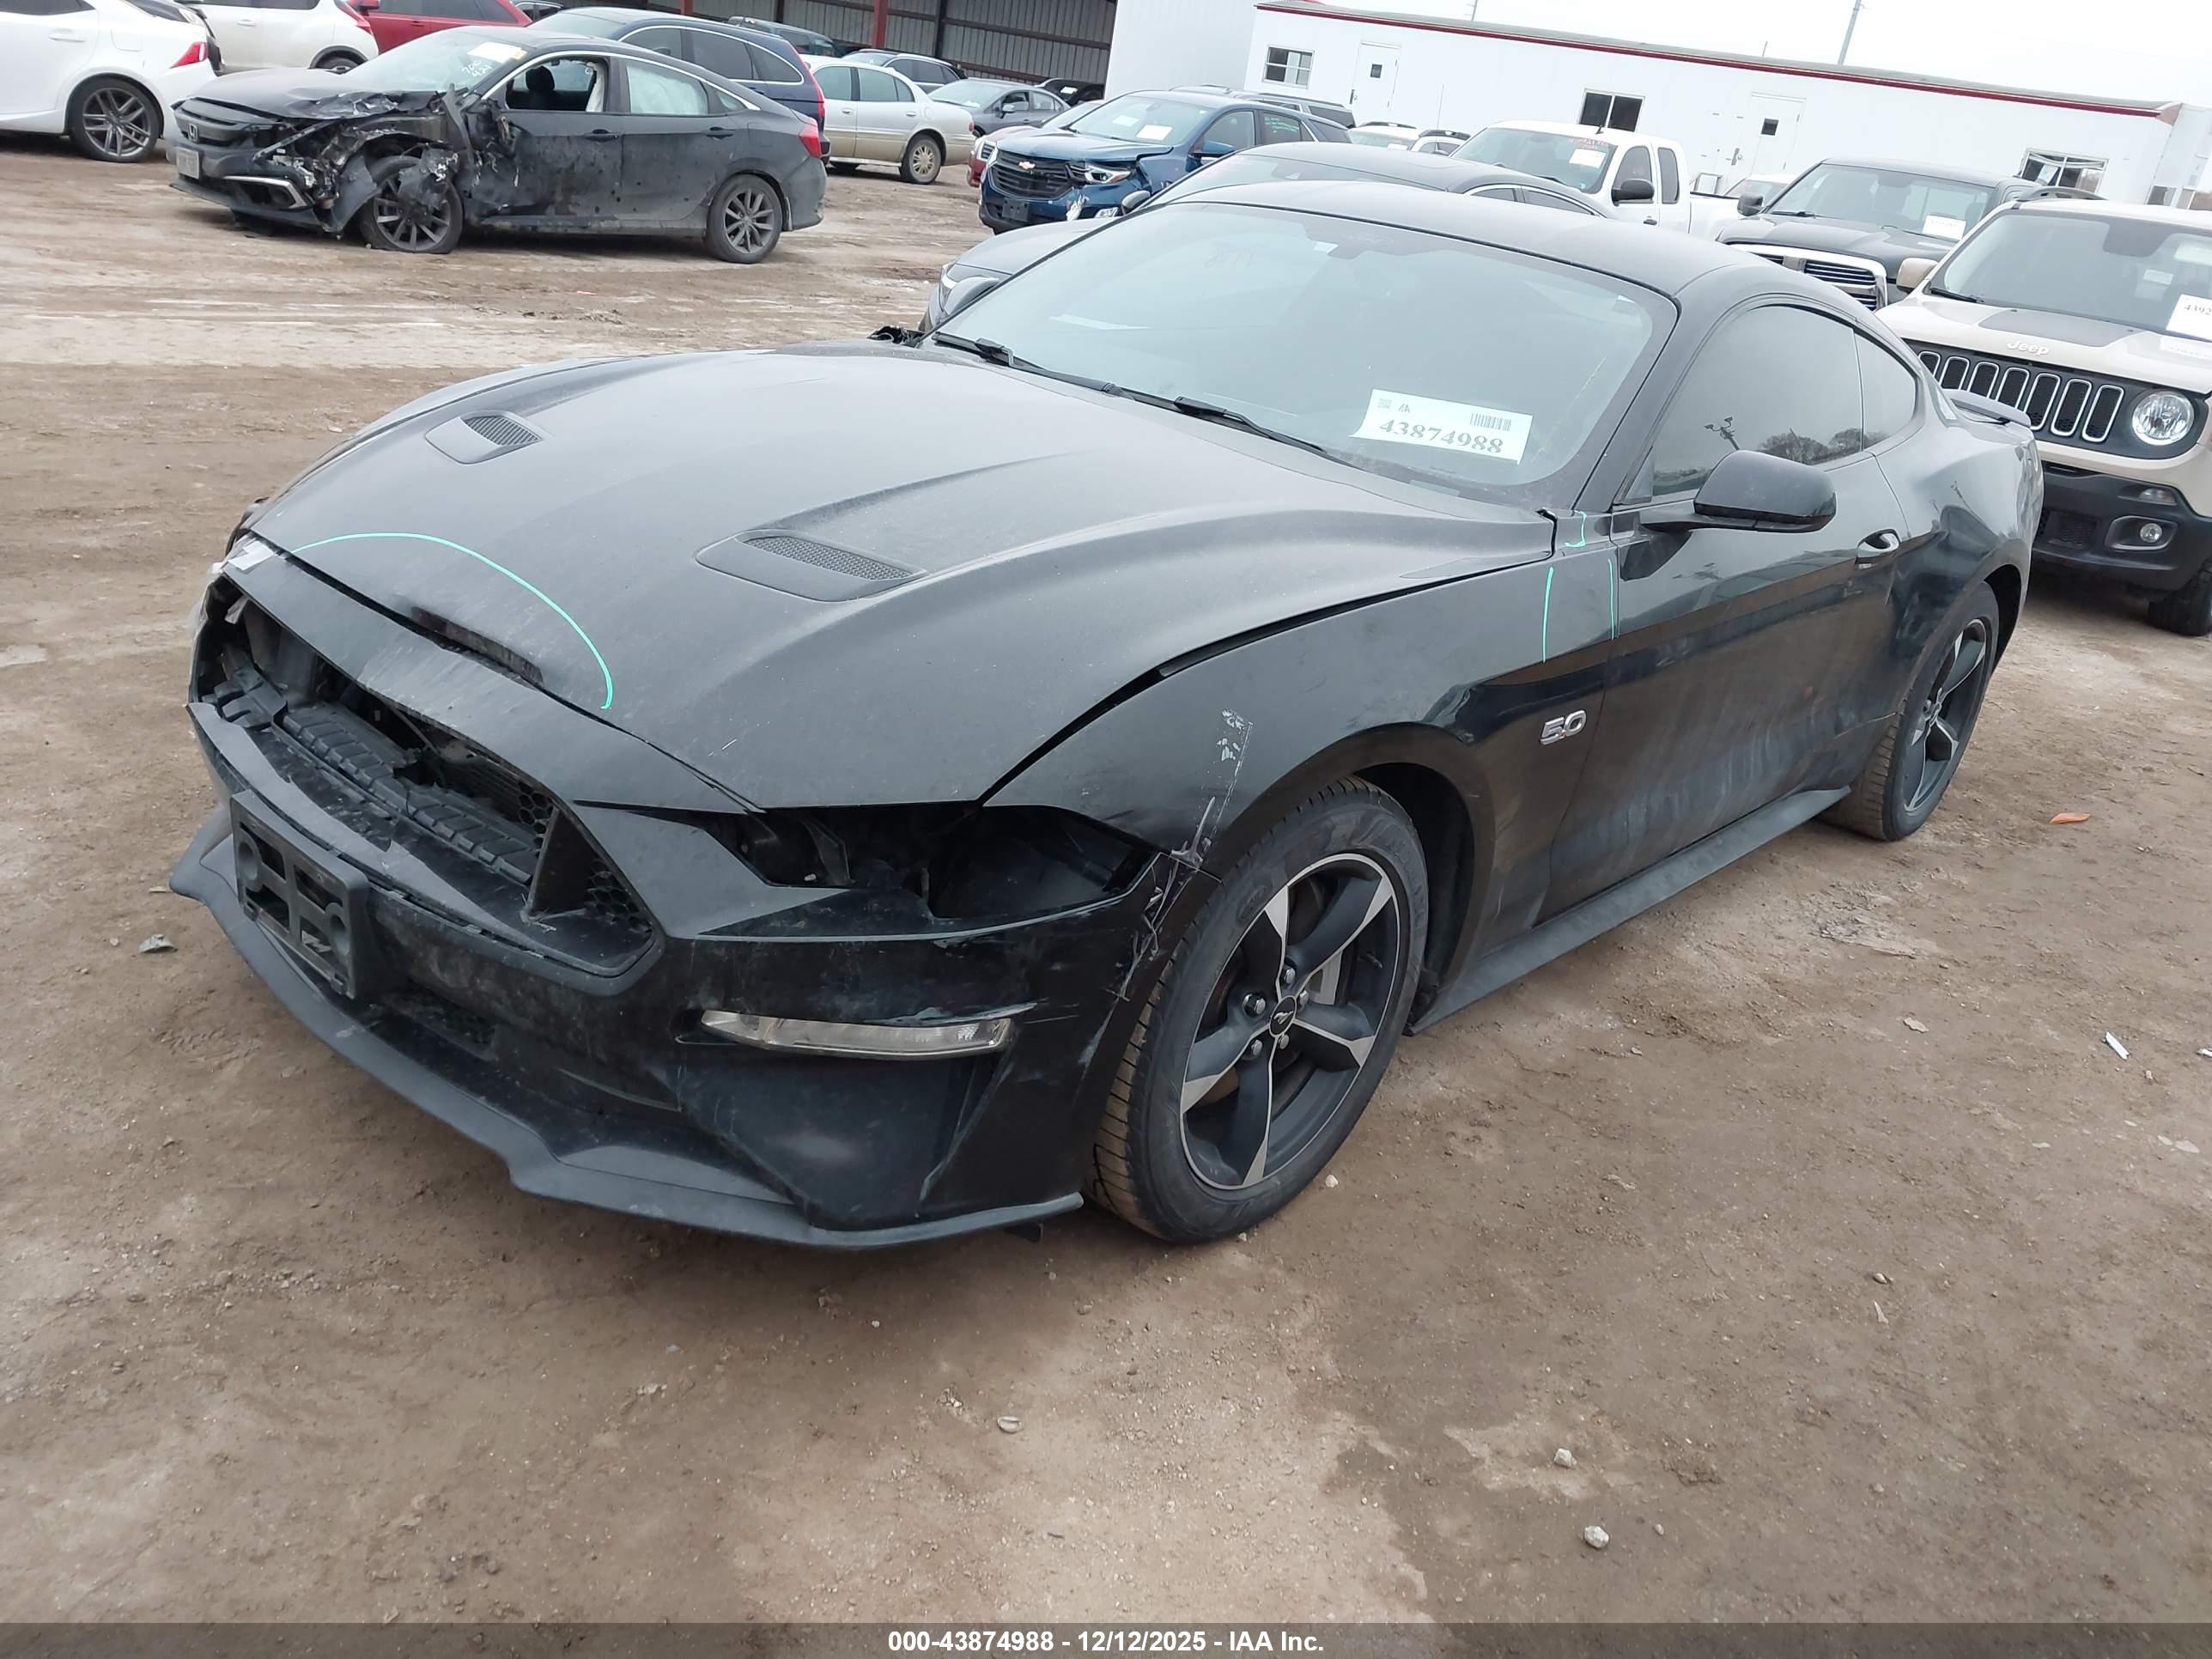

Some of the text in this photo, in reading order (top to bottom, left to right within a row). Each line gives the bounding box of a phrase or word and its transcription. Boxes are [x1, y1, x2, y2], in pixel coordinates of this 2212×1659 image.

[2006, 340, 2049, 356] Jeep
[1379, 419, 1504, 453] 43874988
[1540, 709, 1587, 745] 5.0
